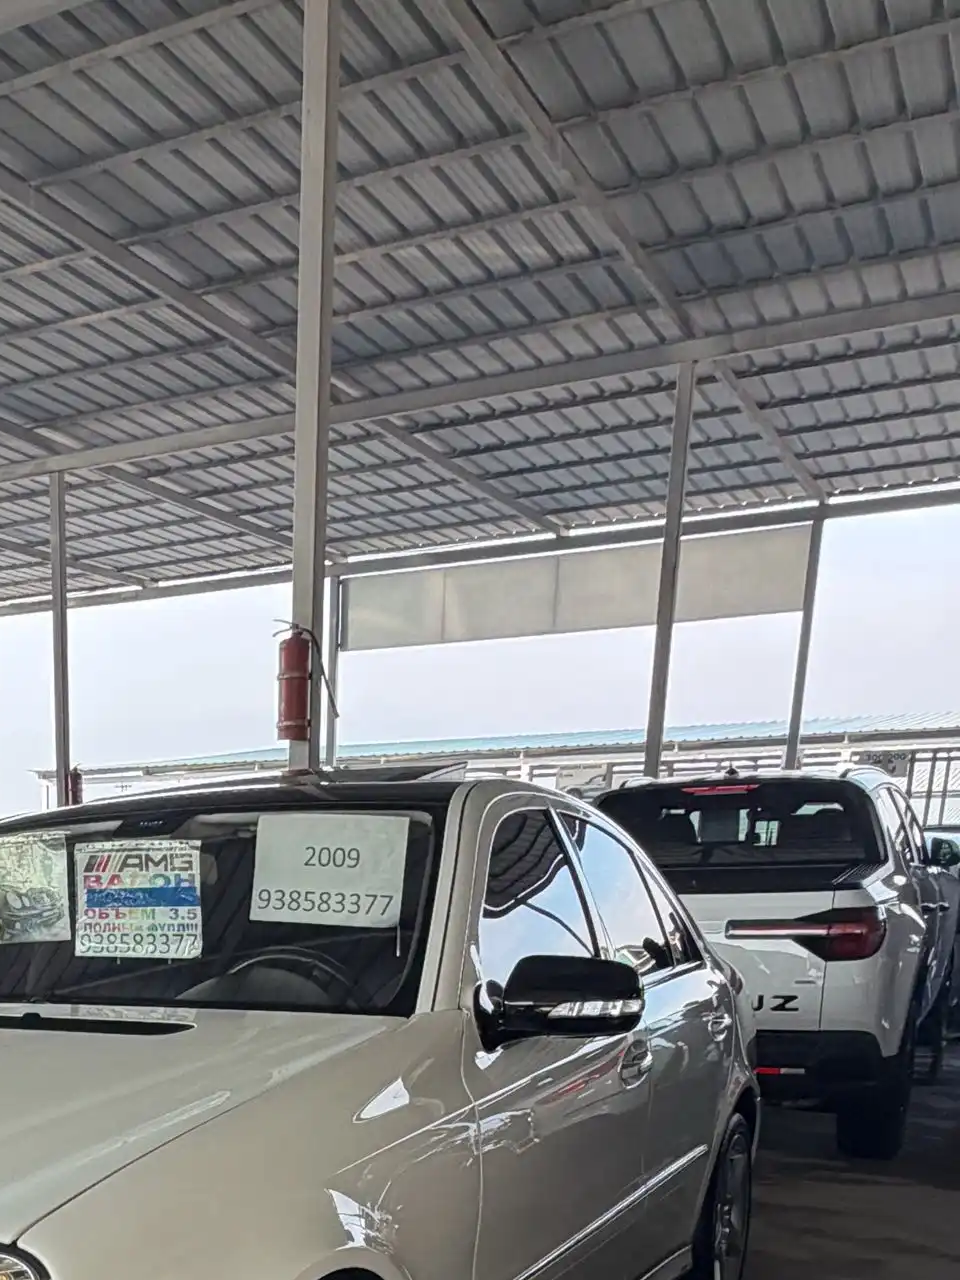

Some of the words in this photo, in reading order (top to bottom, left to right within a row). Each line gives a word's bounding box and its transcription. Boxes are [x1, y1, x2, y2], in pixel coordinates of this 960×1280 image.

[303, 846, 360, 868] 2009
[257, 888, 394, 916] 938583377
[169, 908, 198, 920] 3.5
[79, 933, 198, 954] 938583377
